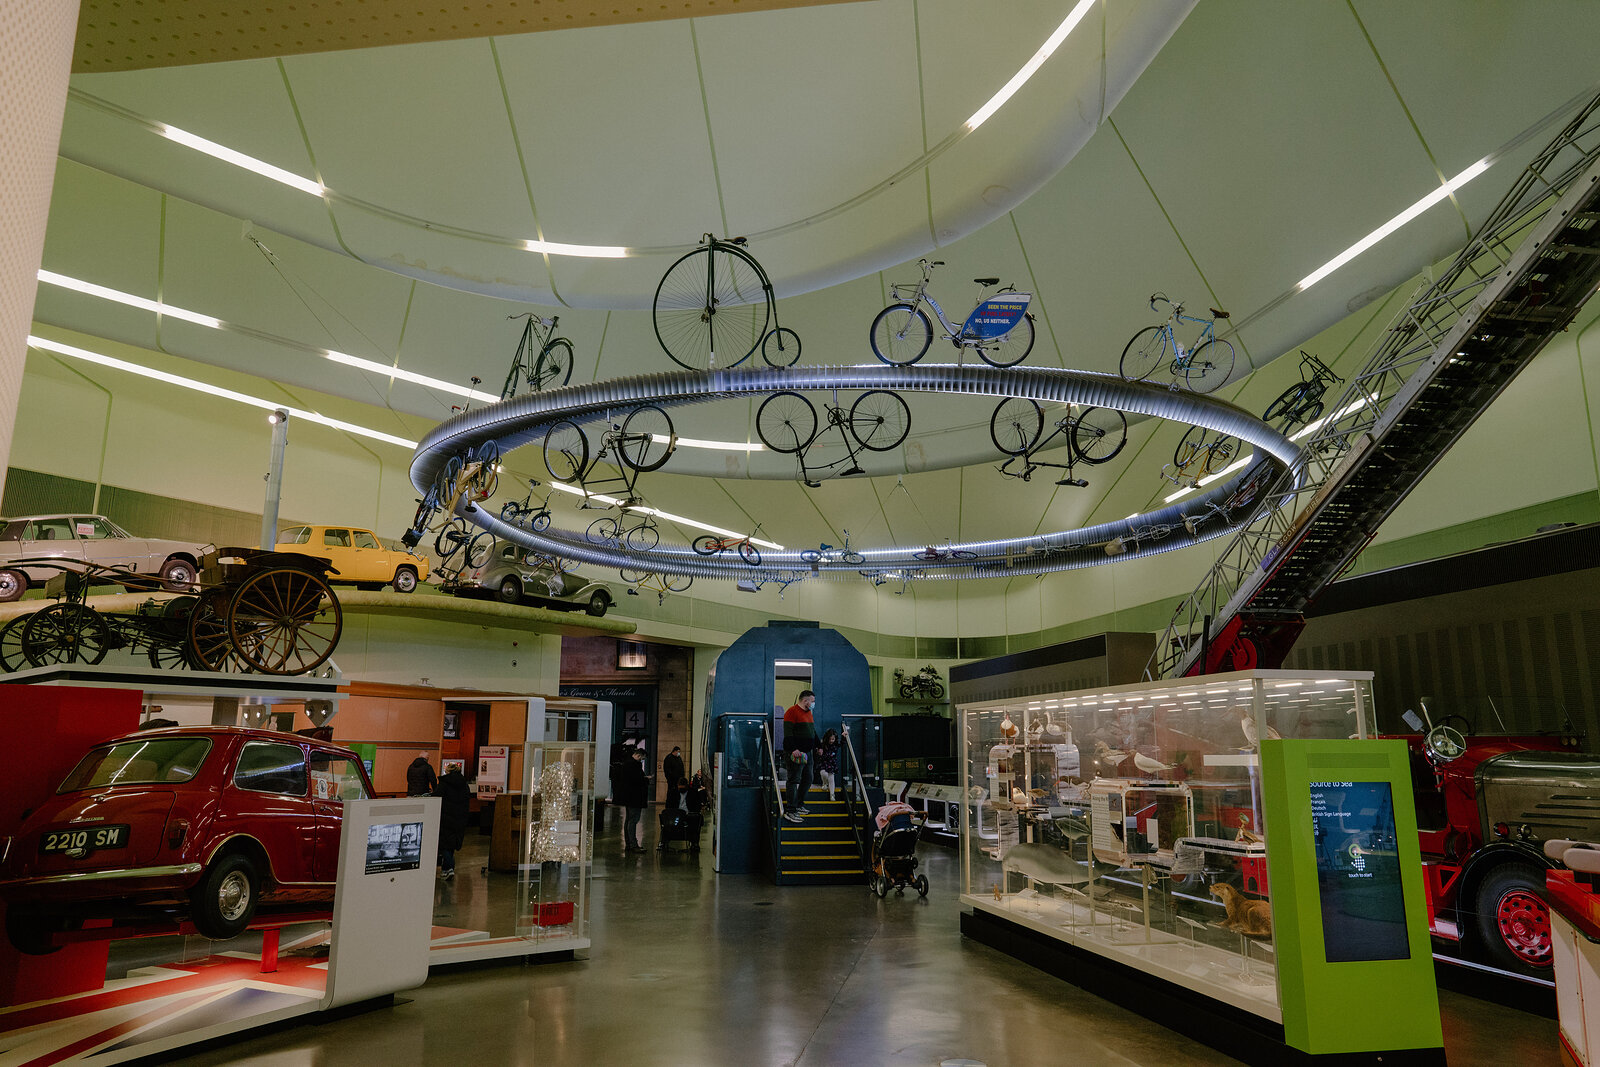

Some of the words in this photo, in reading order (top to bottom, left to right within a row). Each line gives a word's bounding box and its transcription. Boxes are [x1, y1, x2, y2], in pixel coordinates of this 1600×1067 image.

[1268, 523, 1298, 560] GLASGOW
[1305, 495, 1320, 514] FIRE
[629, 712, 640, 726] 4
[45, 831, 88, 850] 2210
[95, 828, 120, 846] SM
